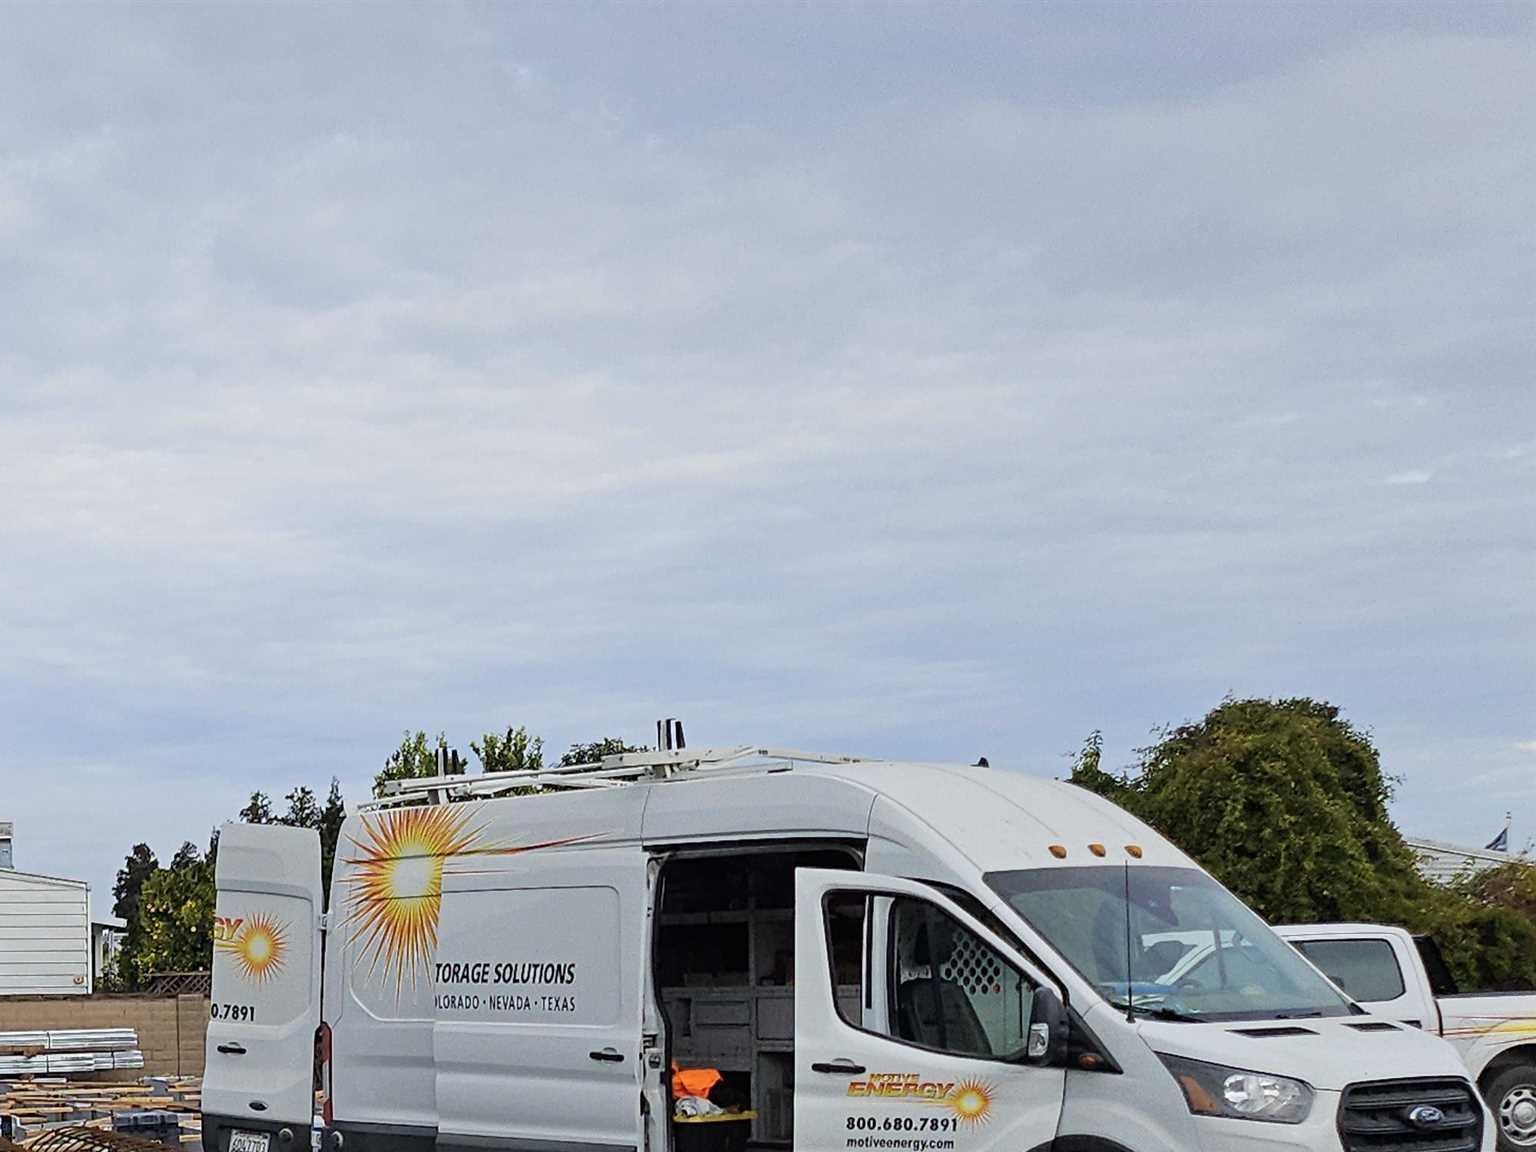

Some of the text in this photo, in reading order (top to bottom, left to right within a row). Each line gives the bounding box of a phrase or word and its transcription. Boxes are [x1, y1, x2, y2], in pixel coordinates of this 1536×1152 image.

[493, 963, 576, 984] SOLUTIONS
[489, 996, 531, 1010] NEVADA
[541, 997, 576, 1011] TEXAS
[211, 1003, 255, 1021] 0.7891
[870, 1073, 920, 1081] MOTIVE
[847, 1082, 955, 1099] ENERGY
[846, 1117, 958, 1132] 800.680.7891
[846, 1136, 954, 1152] motiveenergy.com
